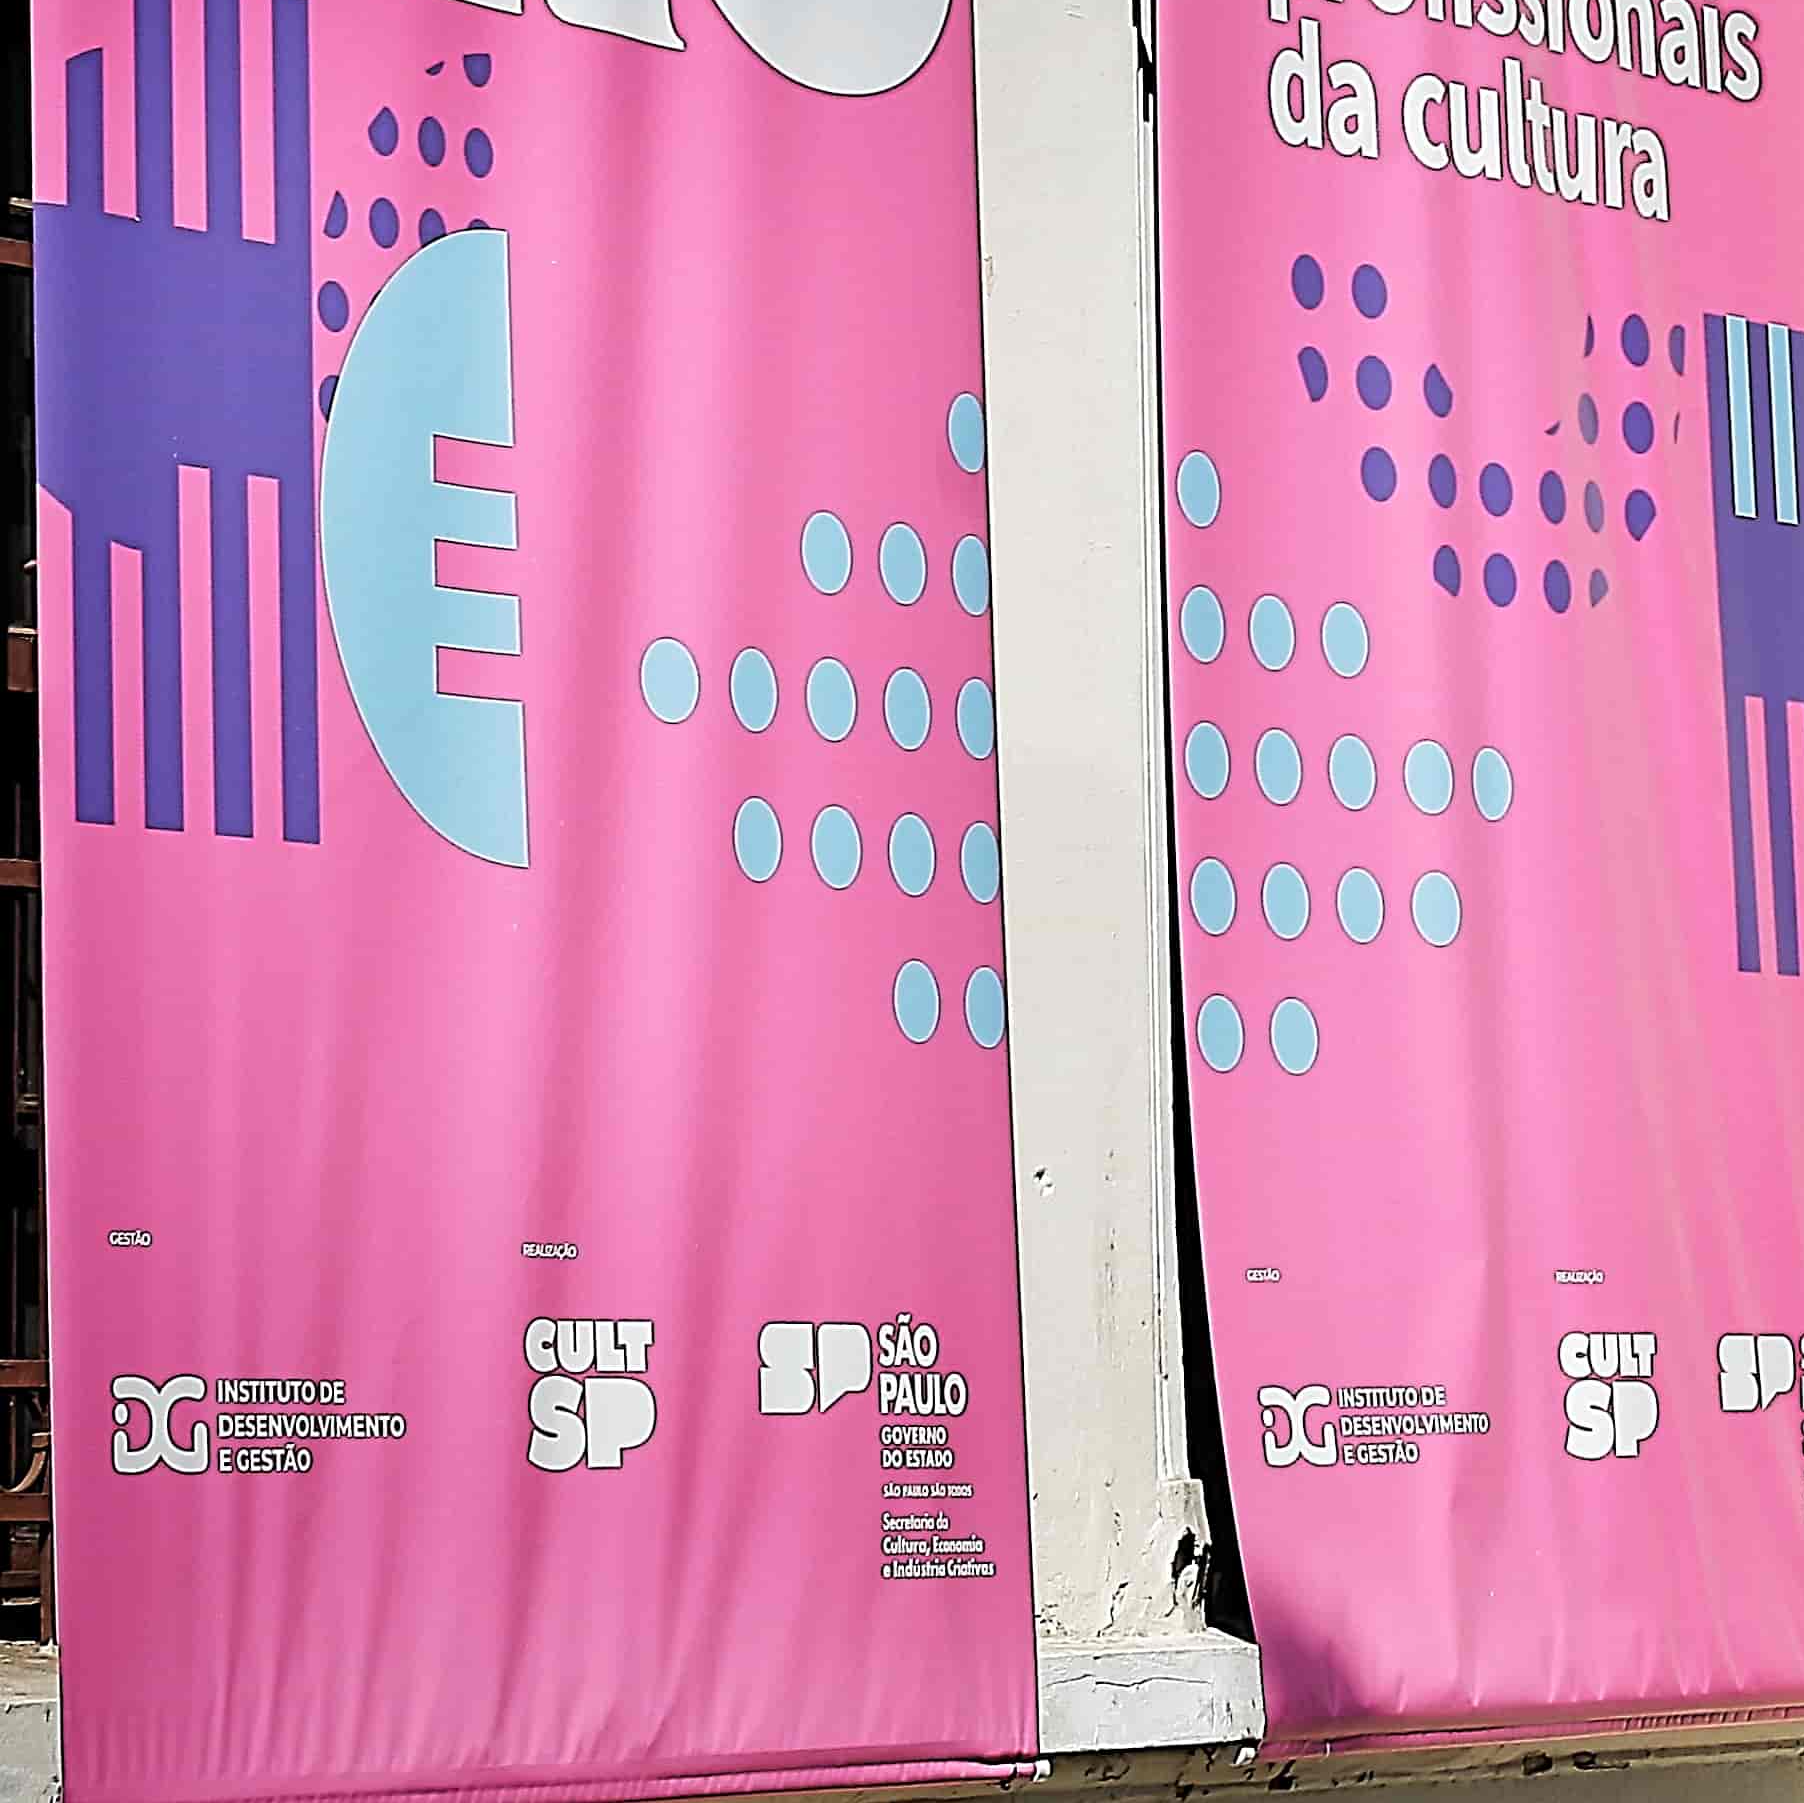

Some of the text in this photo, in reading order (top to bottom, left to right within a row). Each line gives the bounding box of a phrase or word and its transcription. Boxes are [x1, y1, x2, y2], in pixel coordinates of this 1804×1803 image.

[1270, 10, 1673, 221] da cultura
[109, 1230, 151, 1246] GESTÃO
[525, 1319, 653, 1373] CULT
[879, 1313, 937, 1367] SÃO
[1559, 1331, 1656, 1379] CULT
[217, 1379, 345, 1404] INSTITUTO DE
[879, 1373, 966, 1415] PAULO
[1337, 1386, 1447, 1409] INSTITUTO DE
[218, 1414, 405, 1438] DESENVOLVIMENTO
[528, 1375, 655, 1470] SP
[1340, 1411, 1489, 1436] DESENVOLVIMENTO
[1566, 1379, 1658, 1459] SP
[881, 1426, 947, 1445] GOVERNO
[219, 1443, 311, 1472] E GESTÃO
[882, 1449, 953, 1468] DO ESTADO
[1343, 1439, 1419, 1464] E GESTÃO
[882, 1512, 935, 1531] Secretaria
[932, 1534, 983, 1553] Economia
[883, 1557, 995, 1578] e Indústria Criativas
